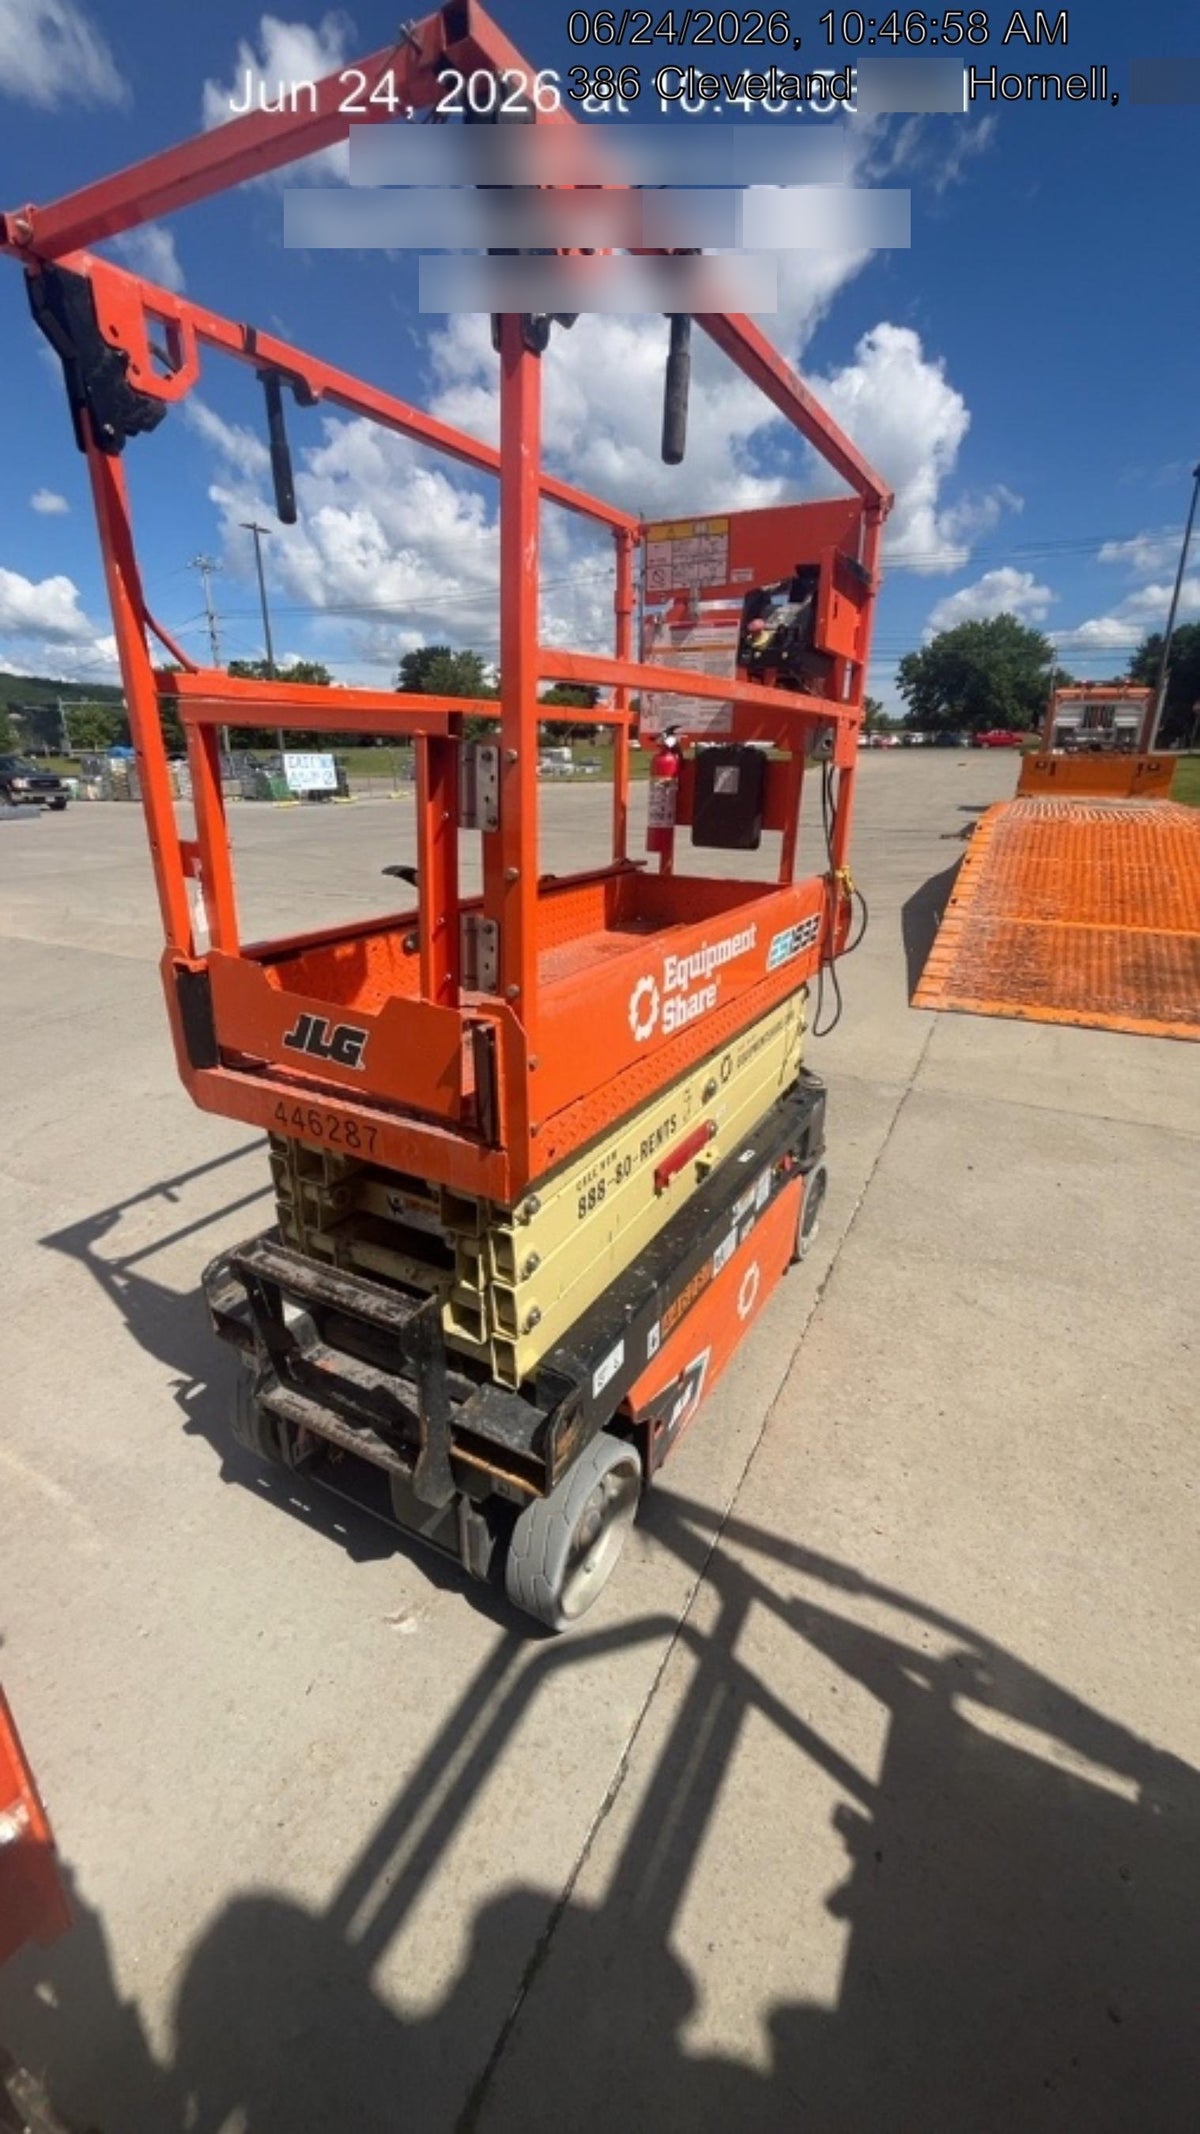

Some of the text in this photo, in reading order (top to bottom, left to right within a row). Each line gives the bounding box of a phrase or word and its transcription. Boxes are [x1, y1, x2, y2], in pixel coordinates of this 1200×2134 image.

[663, 922, 757, 994] Equipment
[662, 982, 718, 1035] Share
[283, 1013, 368, 1069] JLG
[274, 1101, 378, 1152] 446287
